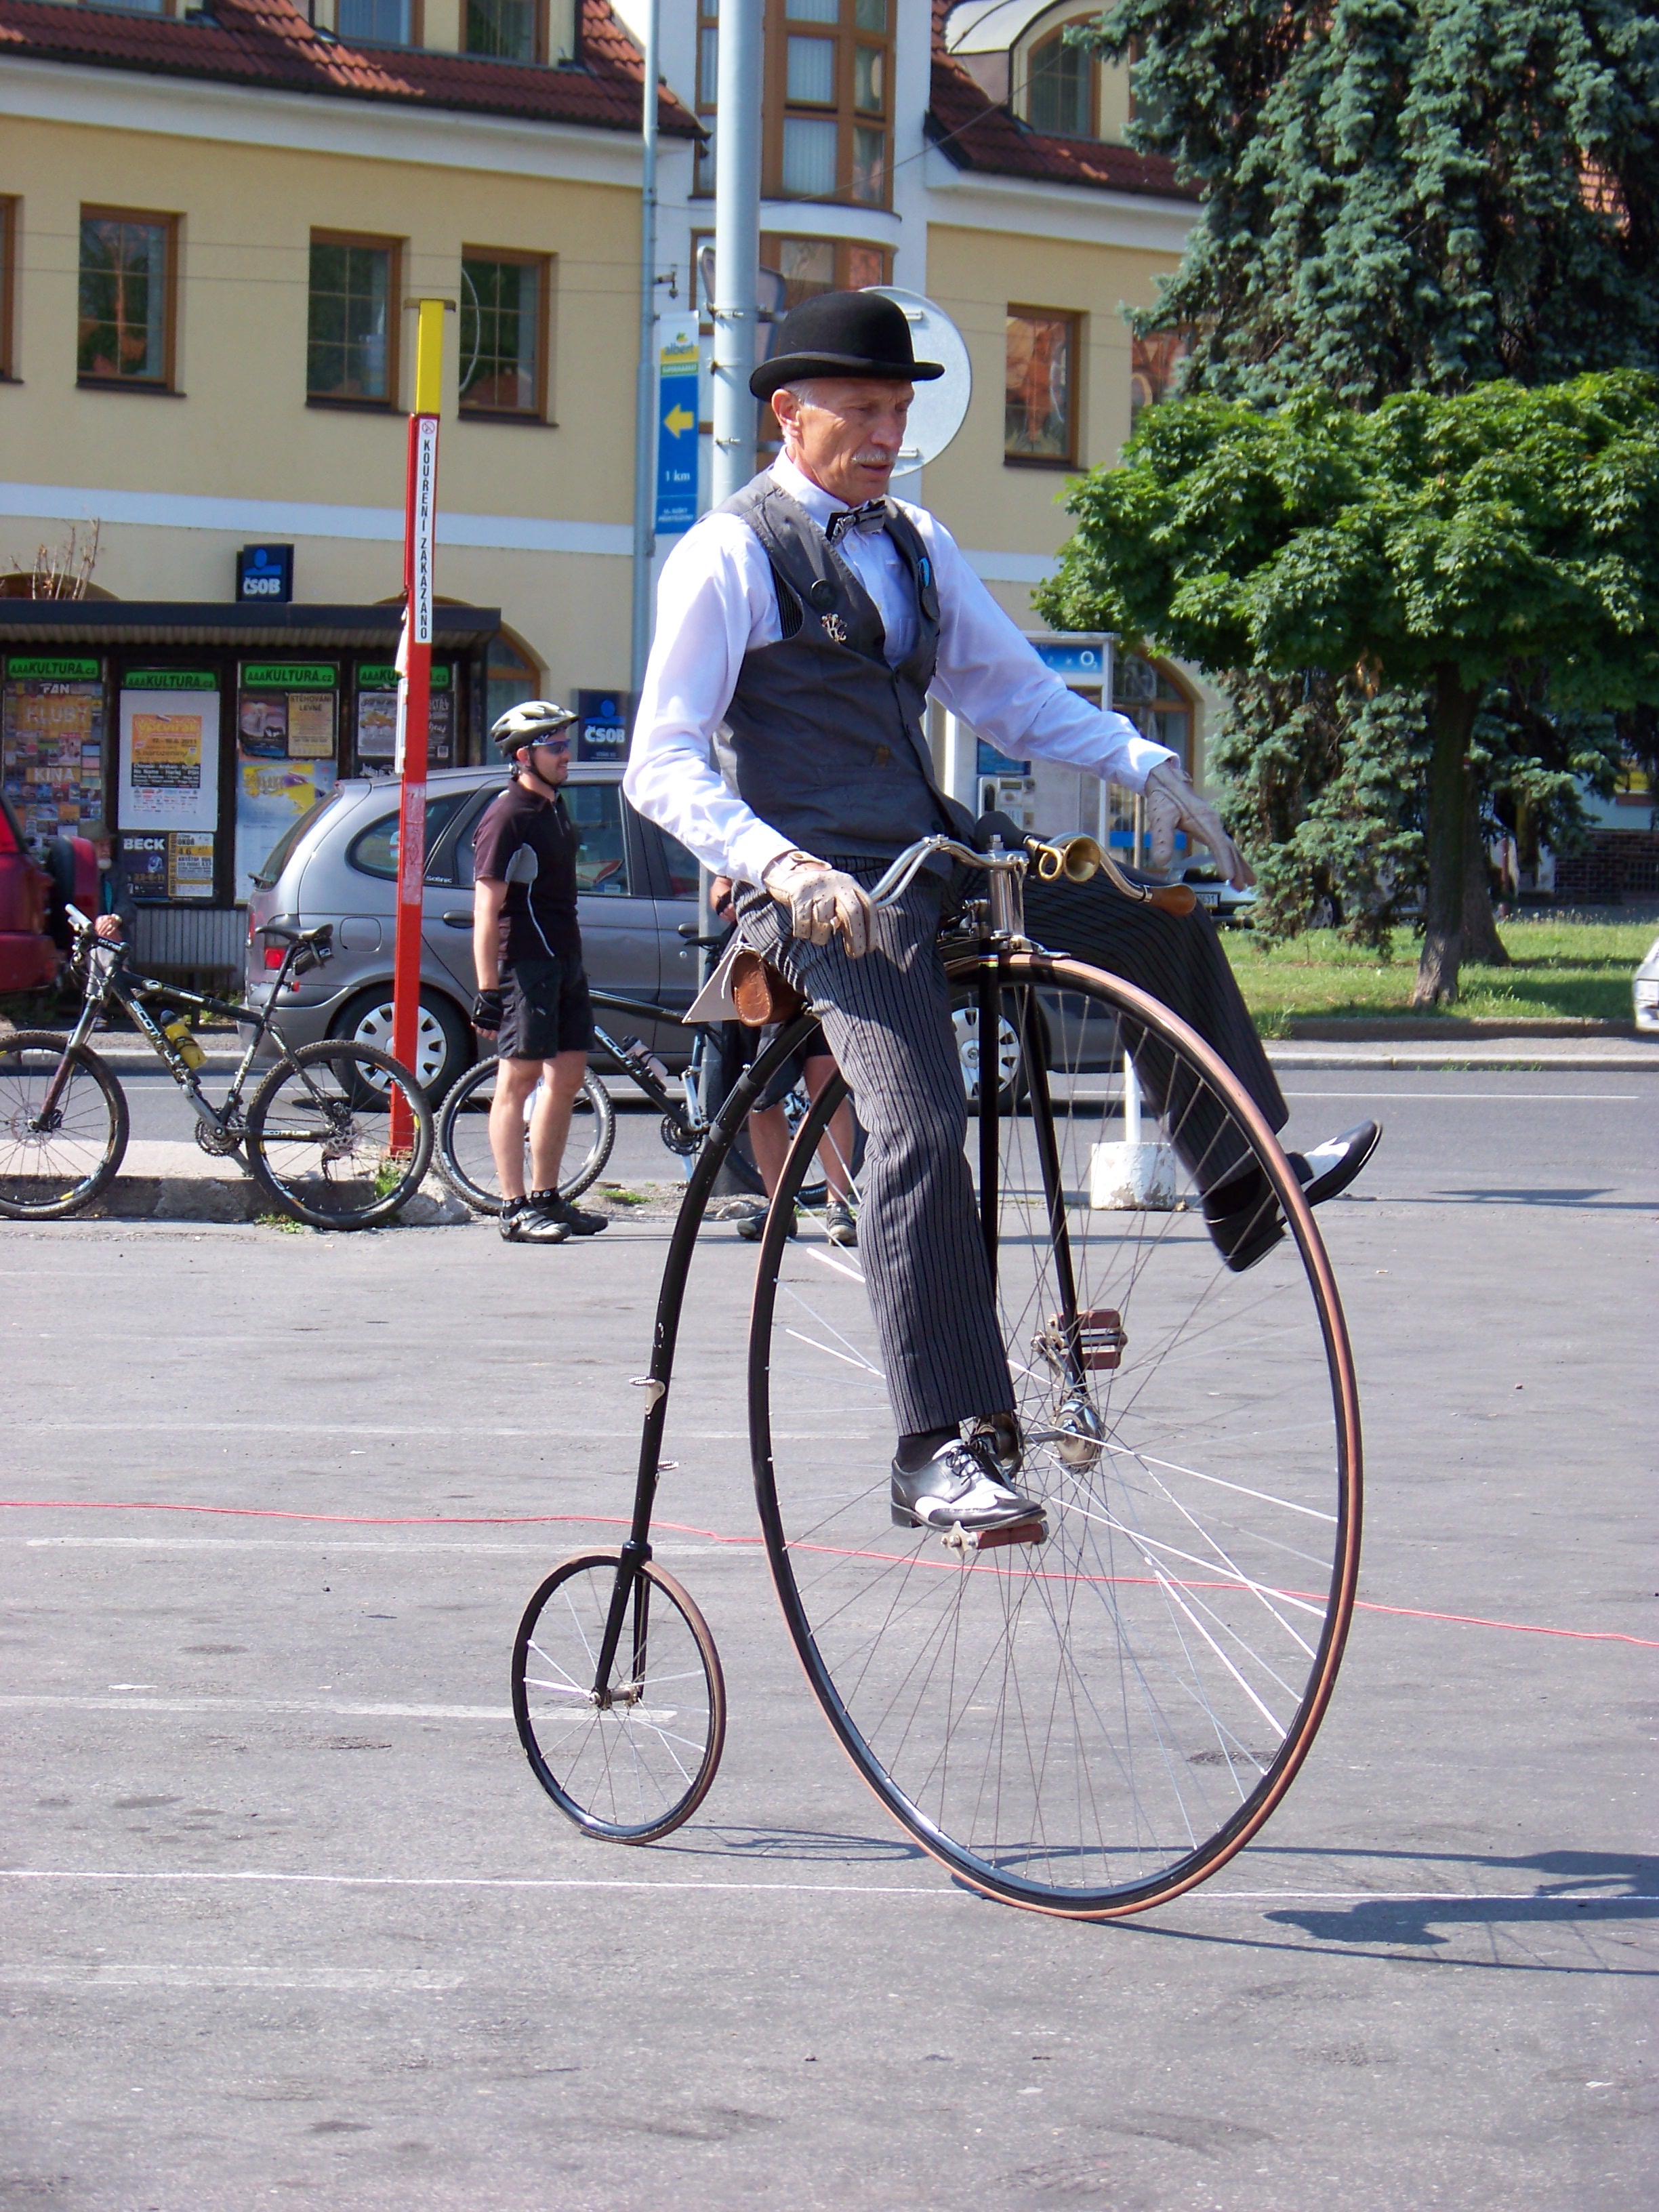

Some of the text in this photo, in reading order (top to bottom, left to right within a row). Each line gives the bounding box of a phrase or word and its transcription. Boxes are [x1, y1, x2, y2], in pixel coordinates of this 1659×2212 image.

[664, 341, 694, 355] albert
[674, 469, 690, 482] km
[421, 439, 430, 531] KOUŘENÍ
[243, 577, 281, 594] ČSOB
[27, 706, 88, 724] KLUBY
[584, 724, 625, 743] ČSOB
[34, 768, 75, 781] KINA
[123, 838, 165, 851] BECK
